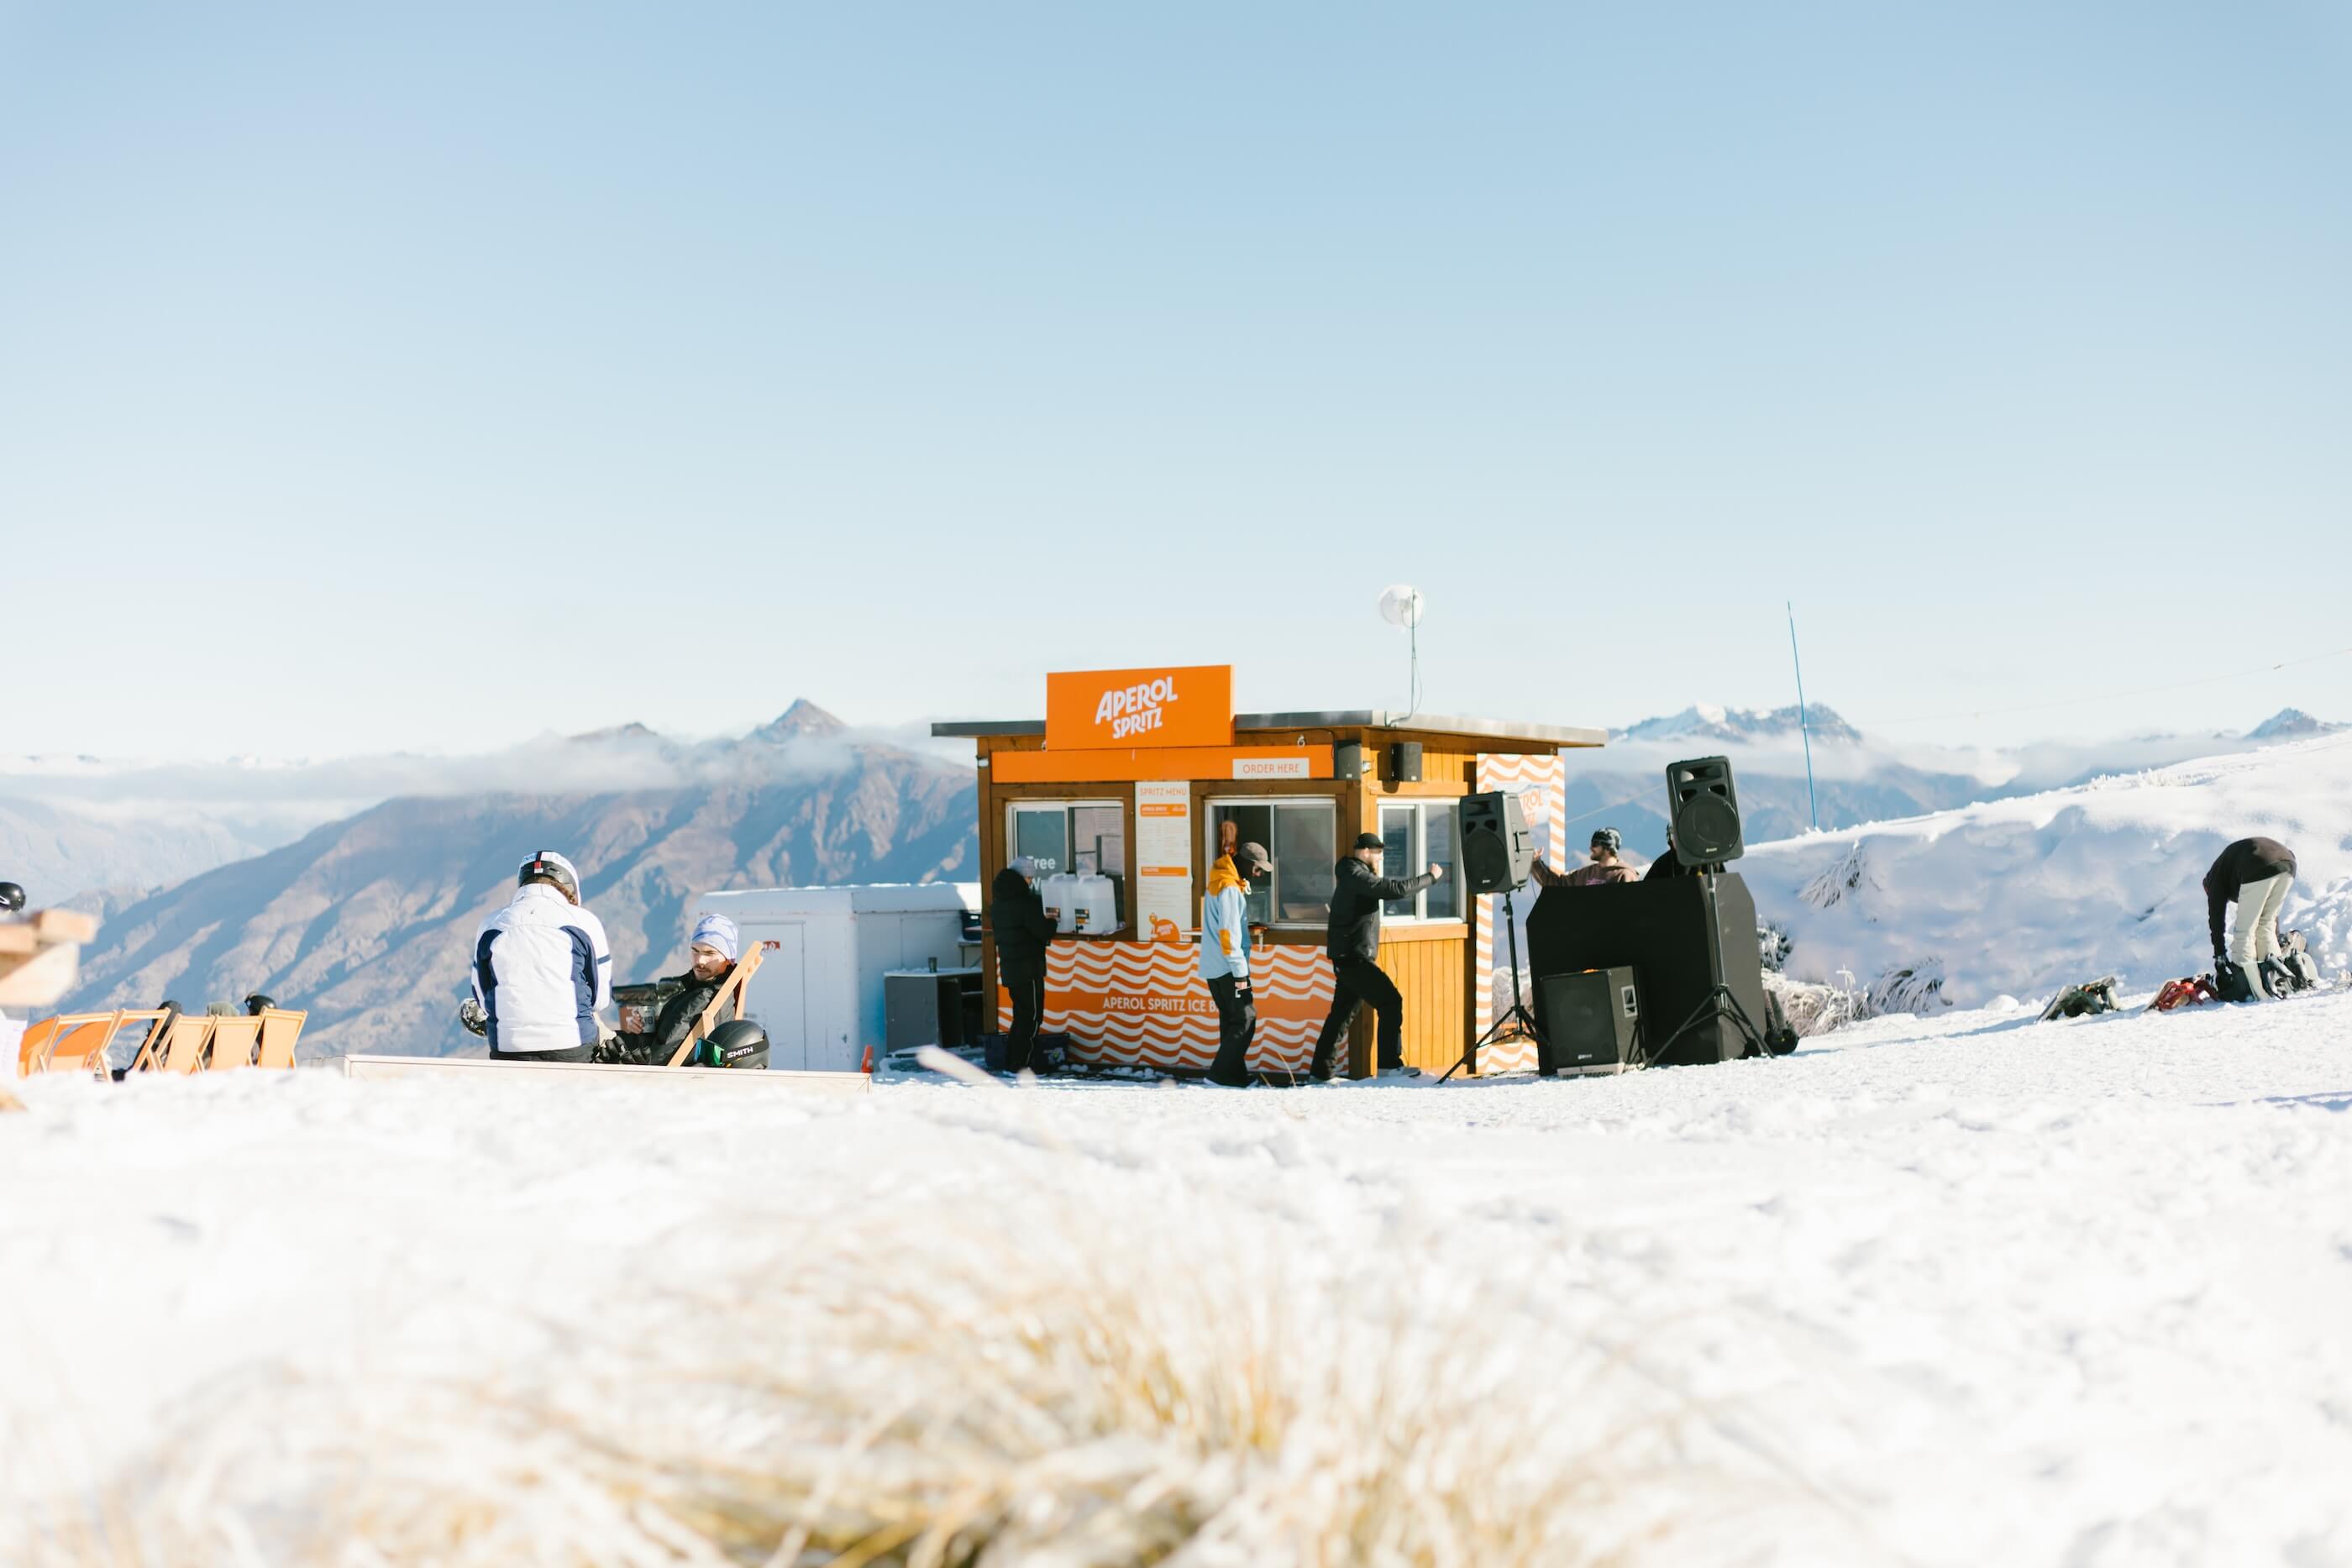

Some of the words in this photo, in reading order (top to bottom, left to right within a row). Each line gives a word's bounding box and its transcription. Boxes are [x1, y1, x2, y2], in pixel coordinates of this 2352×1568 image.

[1095, 676, 1178, 725] APEROL
[1113, 707, 1163, 739] SPRITZ
[1243, 763, 1275, 774] ORDER
[1277, 763, 1300, 774] HERE
[1103, 997, 1145, 1009] APEROL
[1147, 998, 1185, 1011] SPRITZ
[1188, 999, 1206, 1012] ICE
[727, 1046, 753, 1058] SMITH
